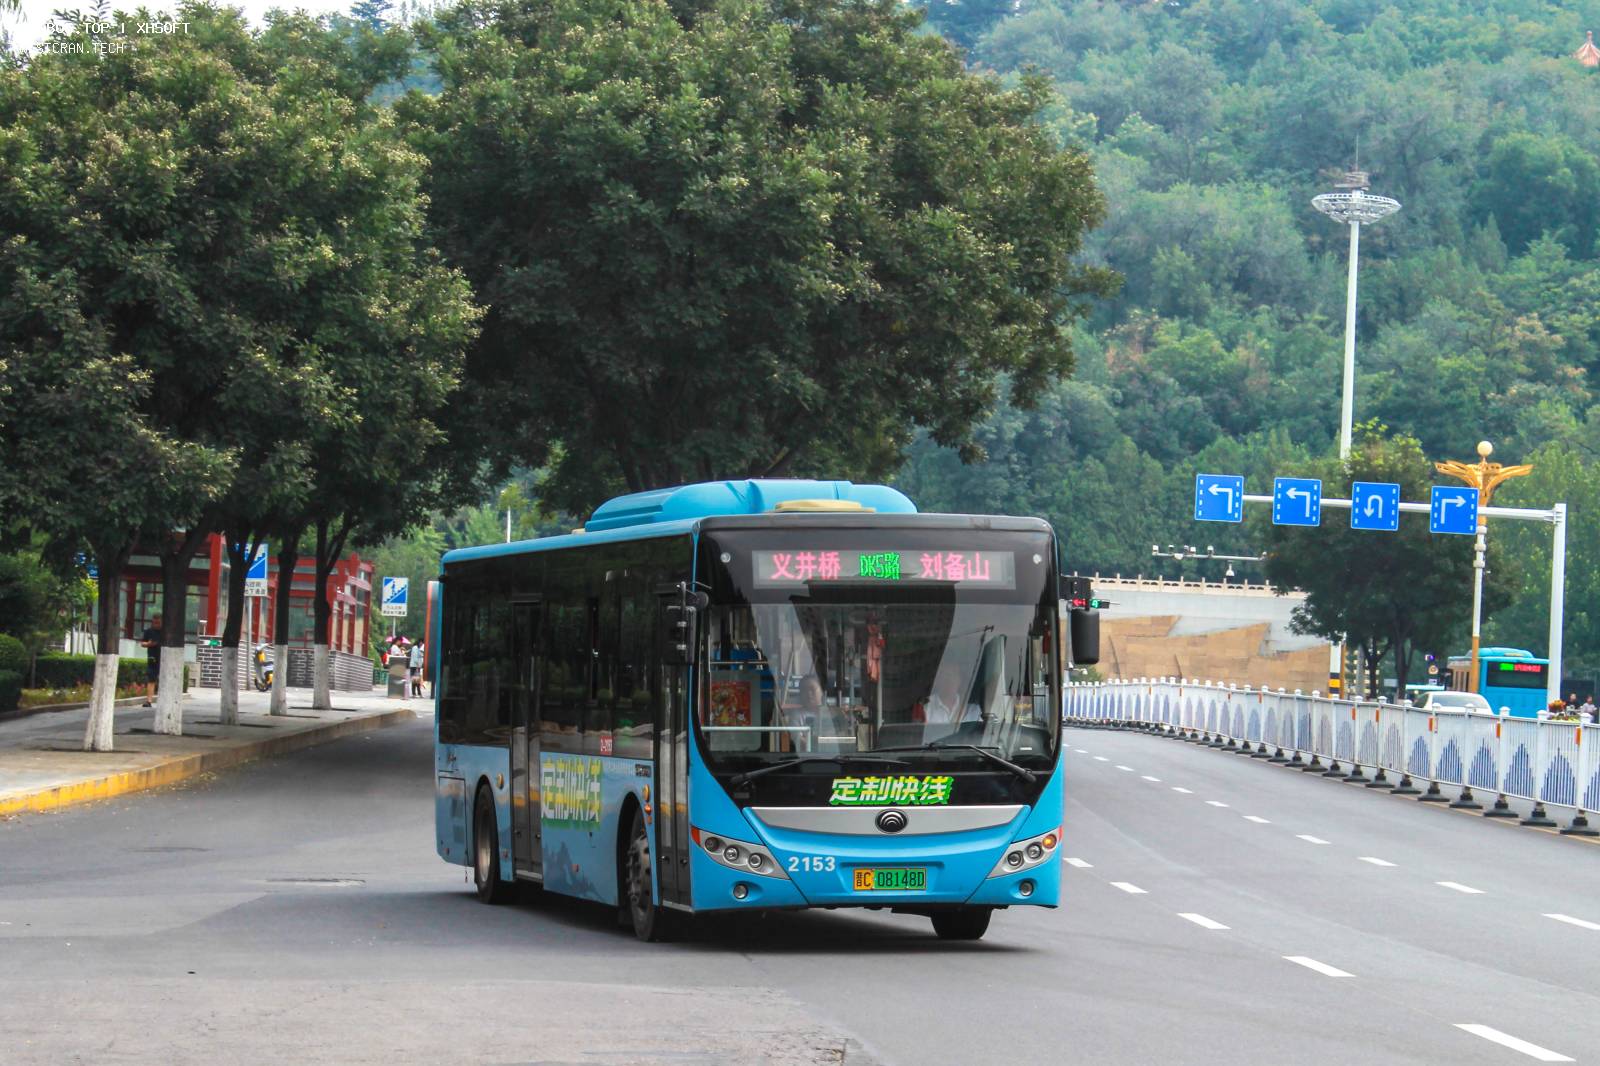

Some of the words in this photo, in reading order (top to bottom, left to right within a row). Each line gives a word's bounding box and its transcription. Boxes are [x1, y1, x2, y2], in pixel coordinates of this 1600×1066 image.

[770, 552, 841, 580] 义井桥
[920, 552, 990, 580] 刘备山
[541, 756, 603, 827] 定制快线
[829, 776, 953, 805] 定制快线
[787, 856, 836, 872] 2153
